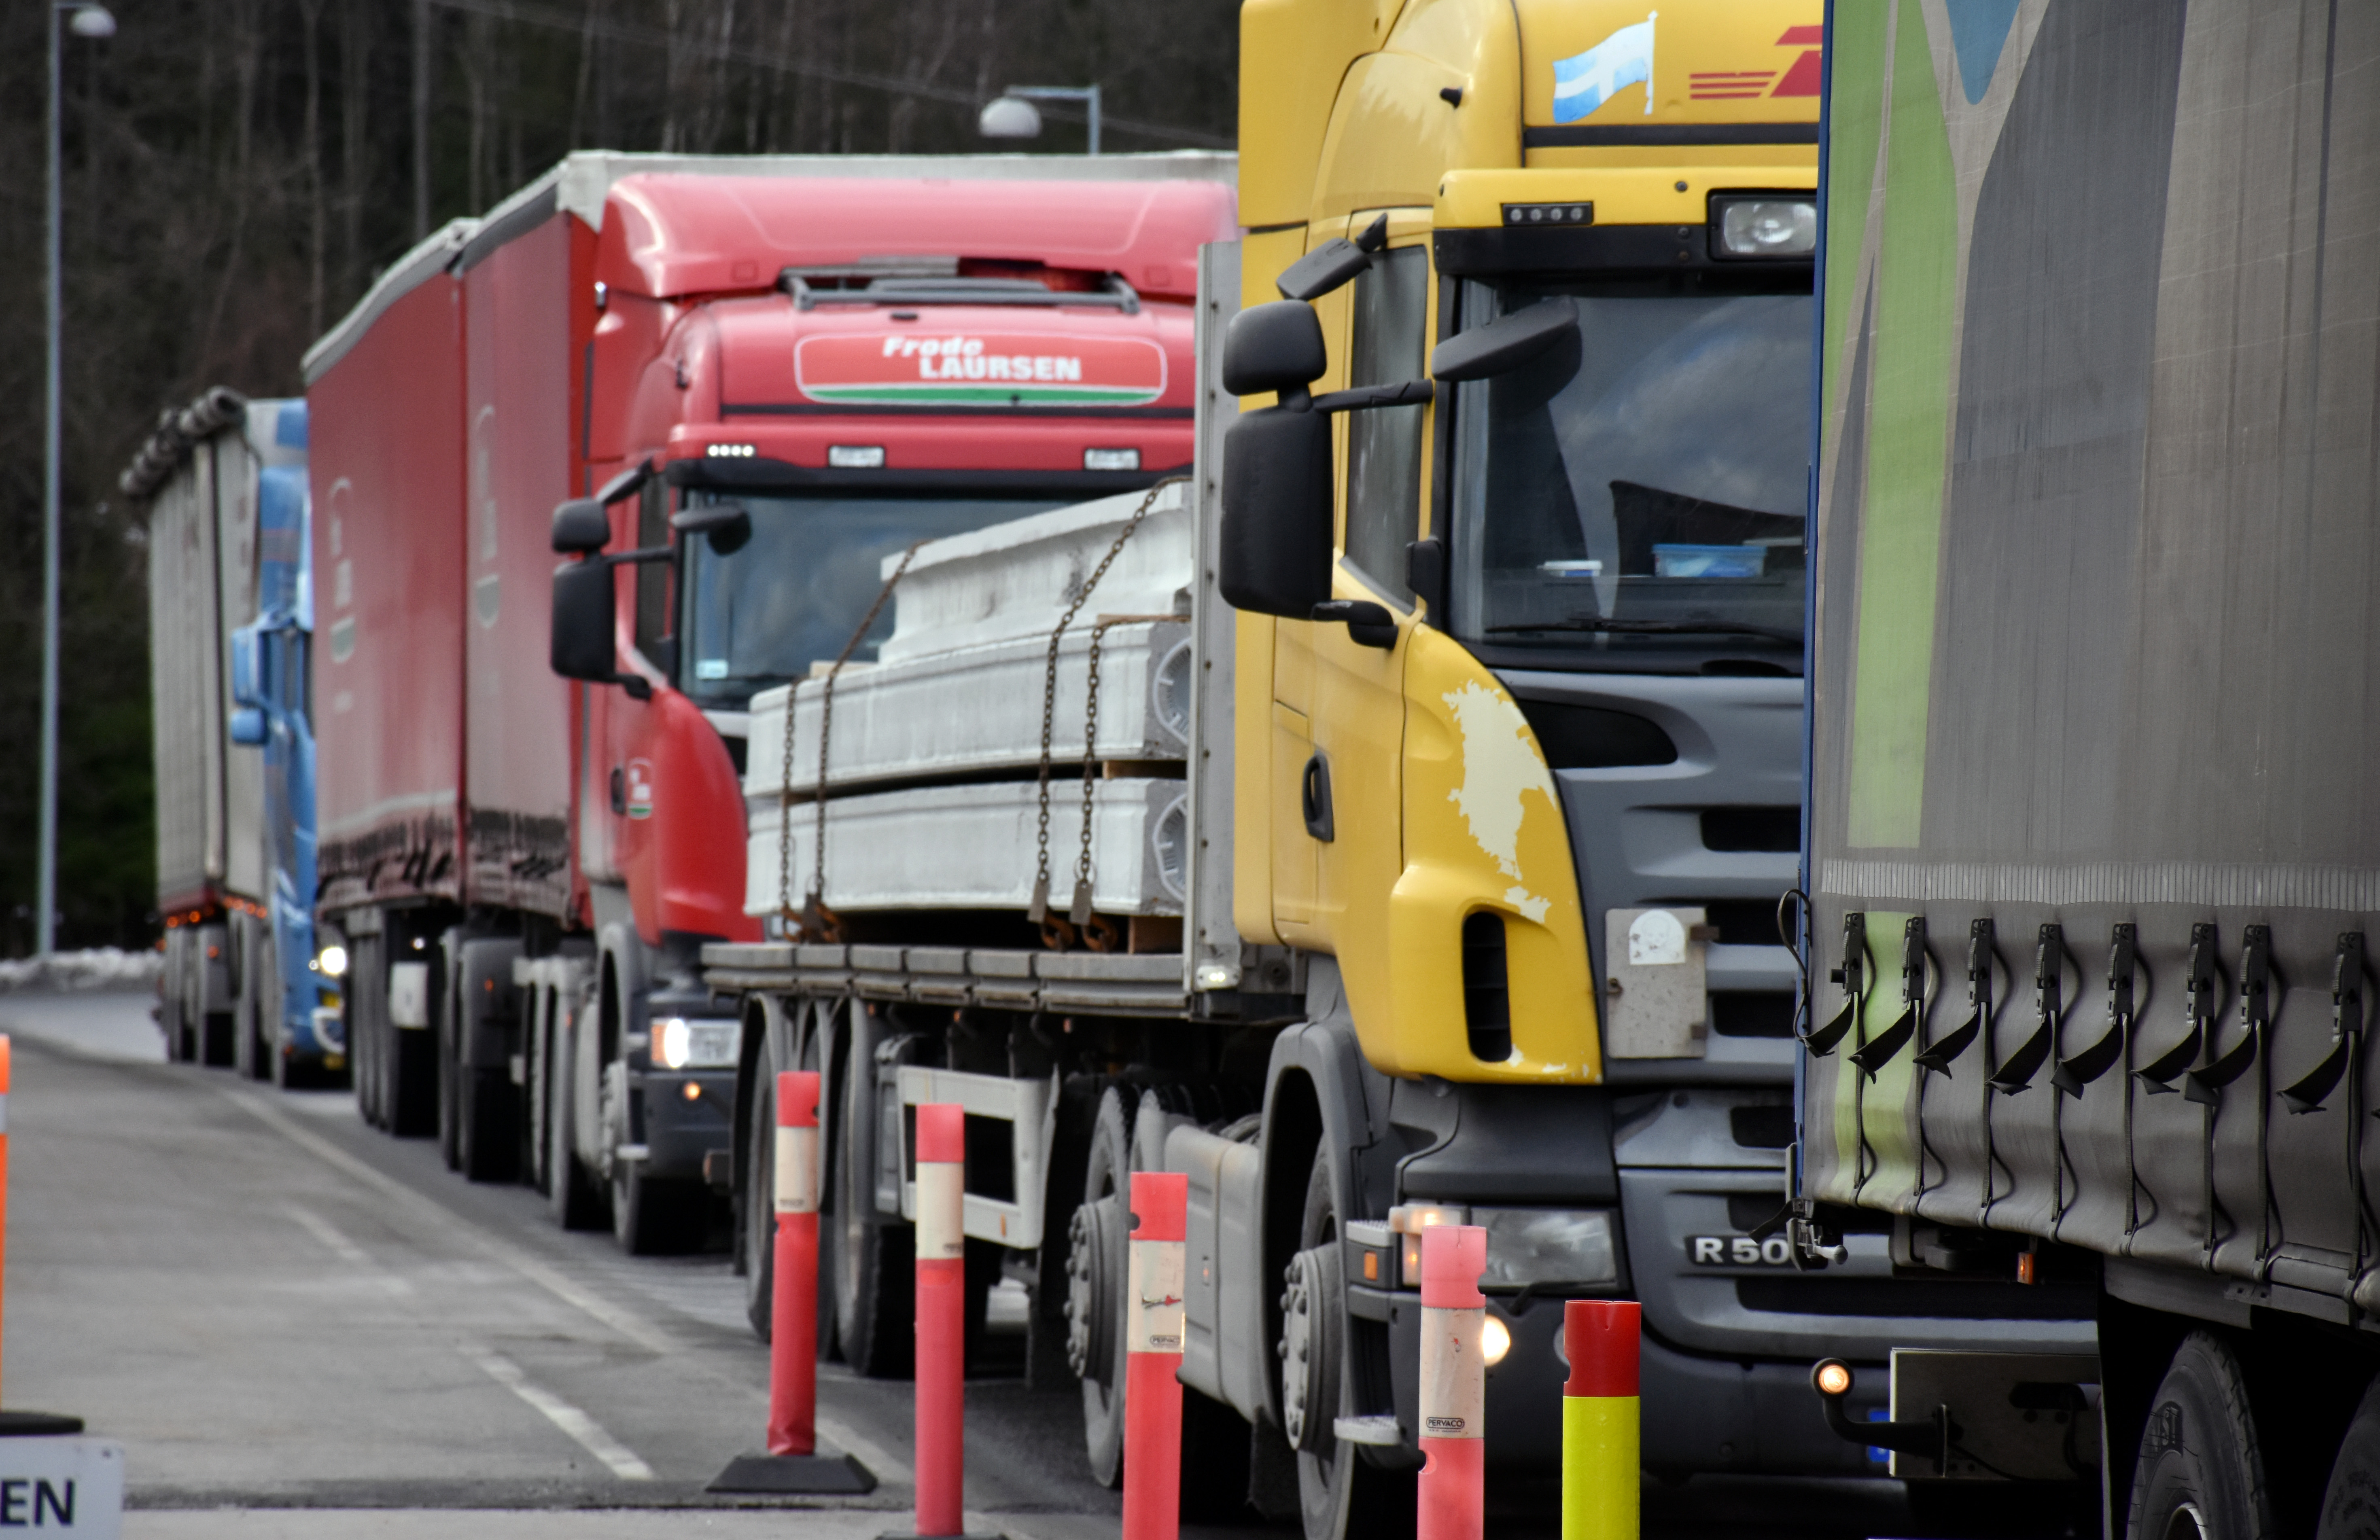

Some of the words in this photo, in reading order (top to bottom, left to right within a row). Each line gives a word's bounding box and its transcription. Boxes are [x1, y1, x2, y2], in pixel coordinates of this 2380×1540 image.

[882, 337, 983, 357] Frode
[919, 356, 1081, 381] LAURSEN
[1695, 1237, 1725, 1264] R
[1731, 1237, 1791, 1264] 50
[1428, 1419, 1463, 1427] PERVACO
[0, 1479, 75, 1527] EN
